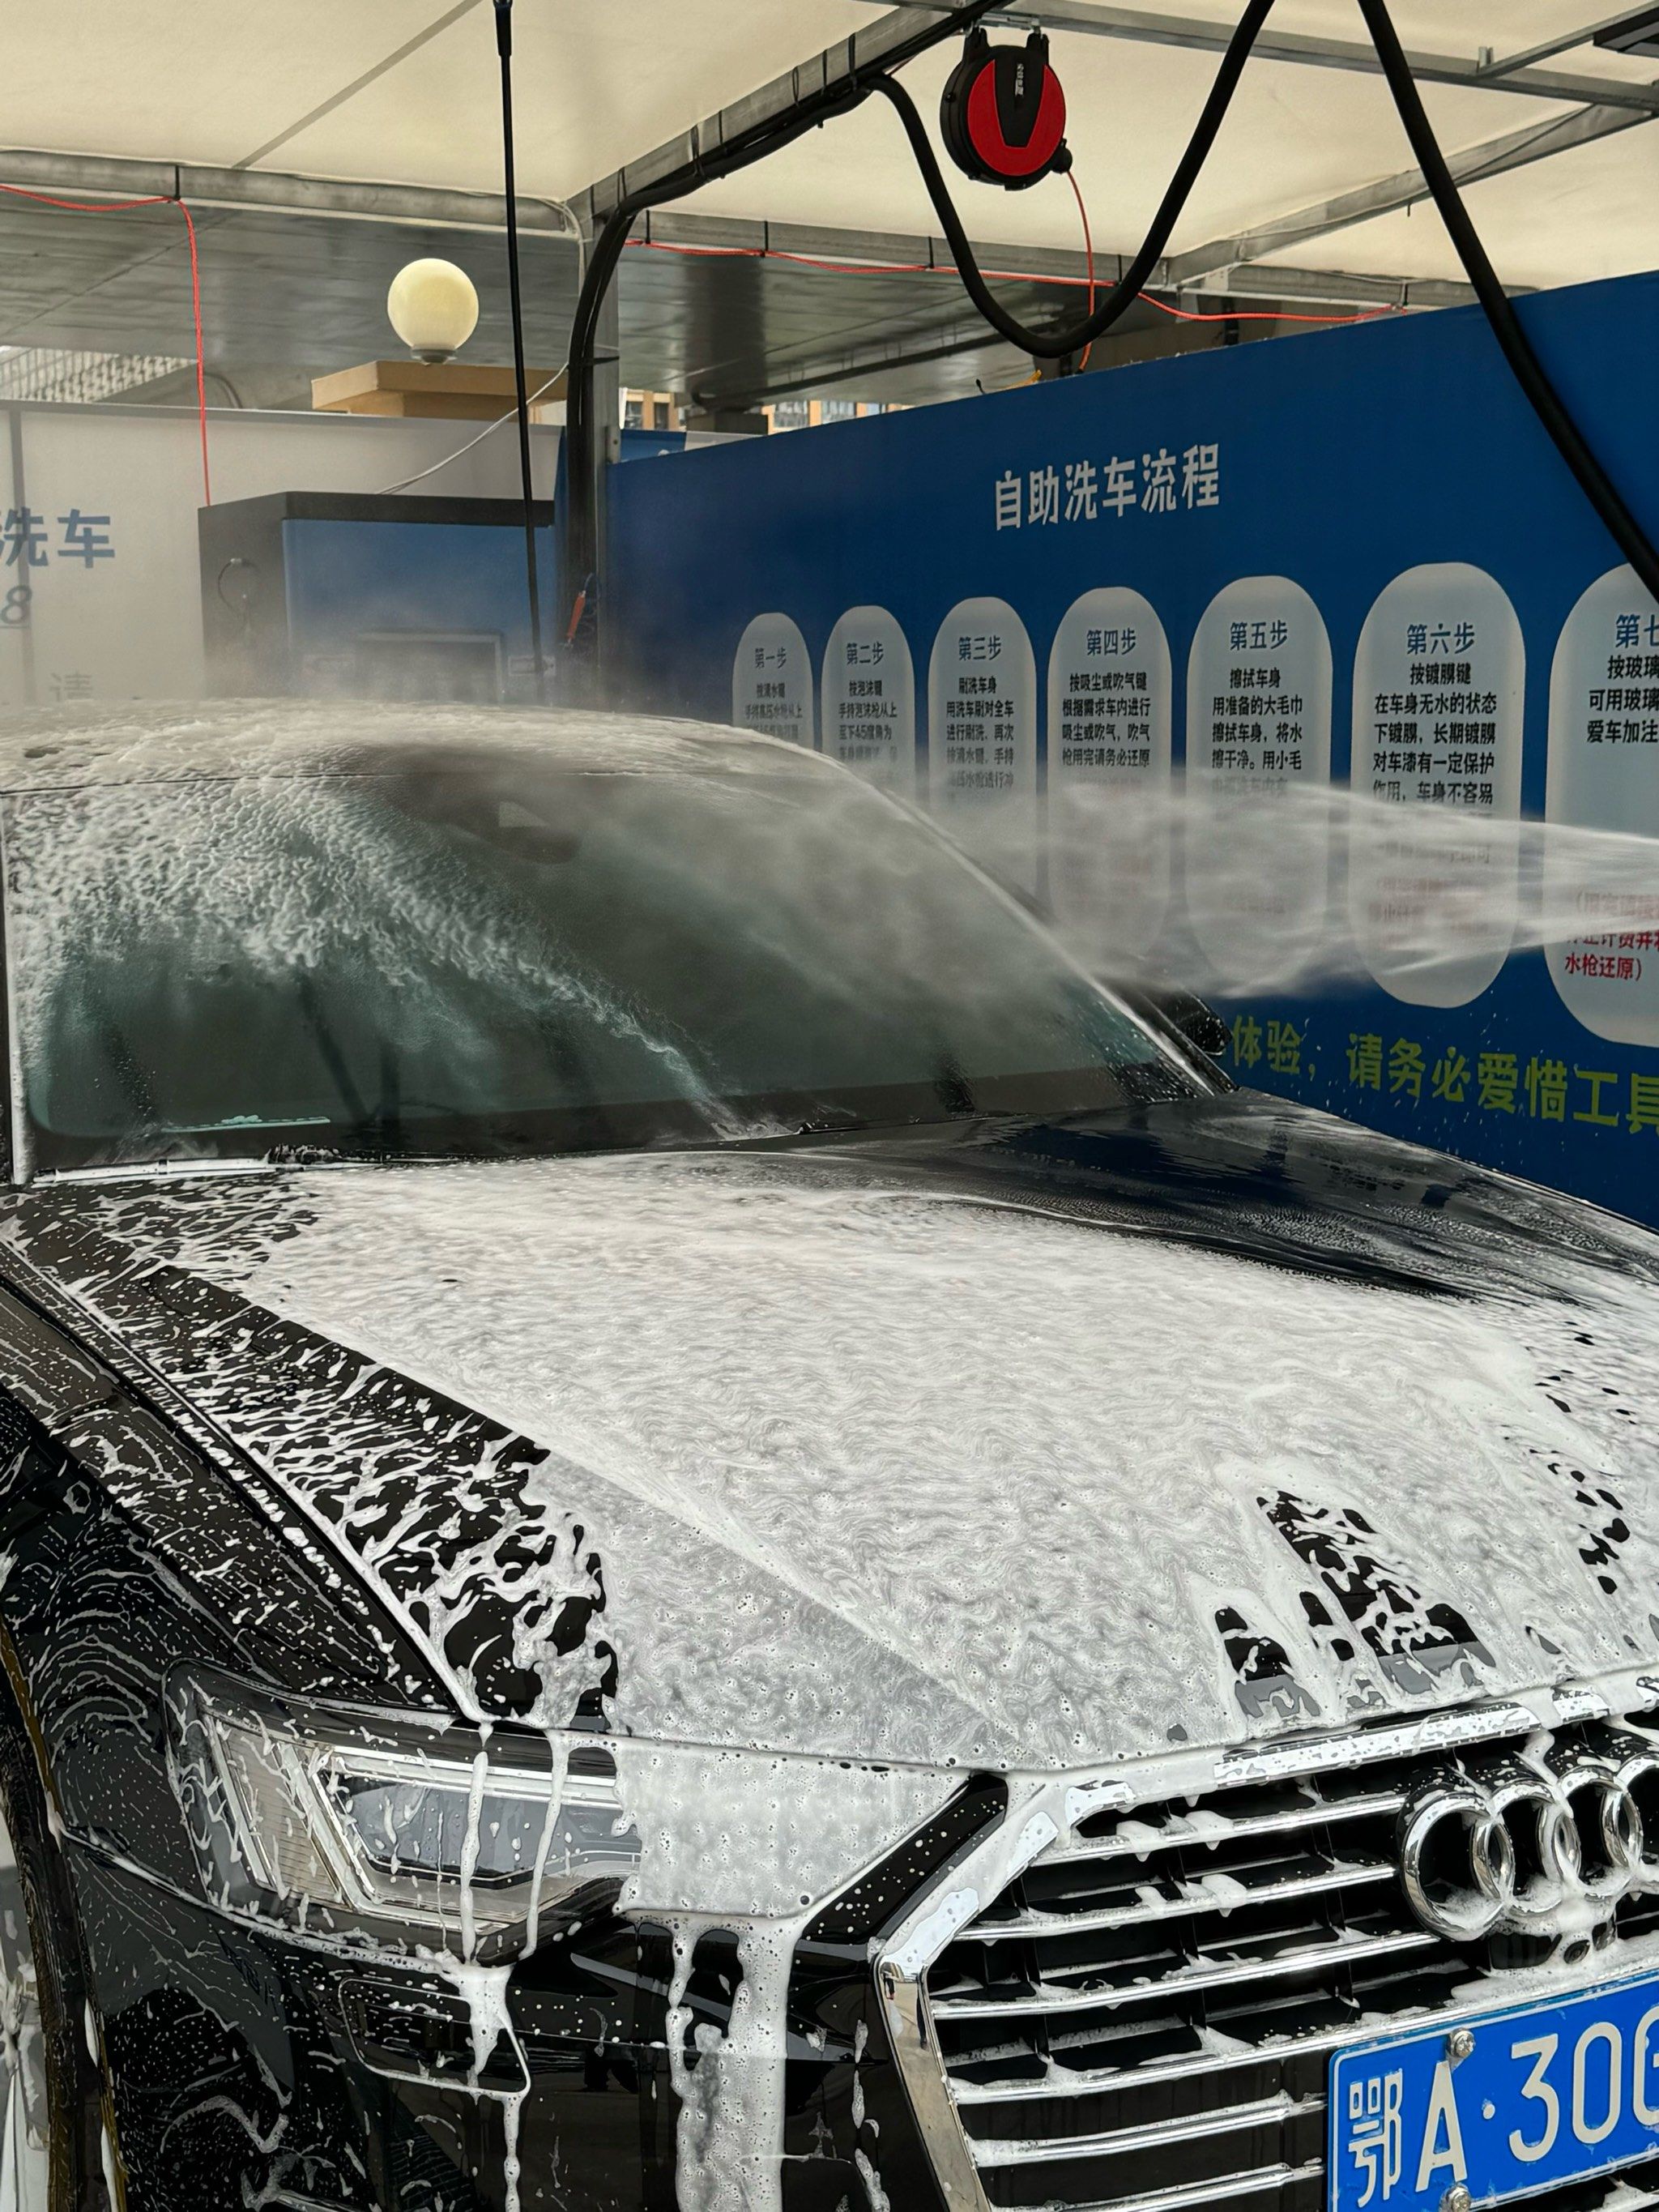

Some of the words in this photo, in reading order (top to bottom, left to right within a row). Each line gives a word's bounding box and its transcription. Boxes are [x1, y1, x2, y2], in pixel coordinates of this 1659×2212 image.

[995, 443, 1219, 531] 自助洗车流程
[0, 506, 115, 568] 洗车
[1086, 628, 1137, 656] 第四步
[1230, 620, 1288, 651] 第五步
[1406, 622, 1475, 655] 第六步
[755, 647, 787, 668] 第一步
[847, 642, 884, 665] 第二步
[959, 635, 1001, 660] 第三步
[1070, 672, 1147, 692] 按吸尘或吹气键
[1230, 668, 1281, 689] 擦拭车身
[1410, 663, 1471, 685] 按镀膜键
[946, 700, 1014, 718] 用洗车刷对全车
[1062, 698, 1150, 717] 根据需求车内进行
[1212, 694, 1303, 716] 用准备的大毛巾
[1374, 691, 1497, 715] 在车身无水的状态
[1589, 688, 1659, 711] 可用玻璃
[1062, 724, 1150, 741] 吸尘或吹气，吹气
[1212, 723, 1303, 743] 擦拭车身，将水
[1375, 722, 1496, 745] 下镀膜，长期镀膜
[1587, 720, 1659, 743] 爱车加注
[1062, 748, 1150, 767] 枪用完请务必还原
[1212, 749, 1303, 771] 擦干净。用小毛
[1373, 751, 1495, 774] 对车漆有一定保护
